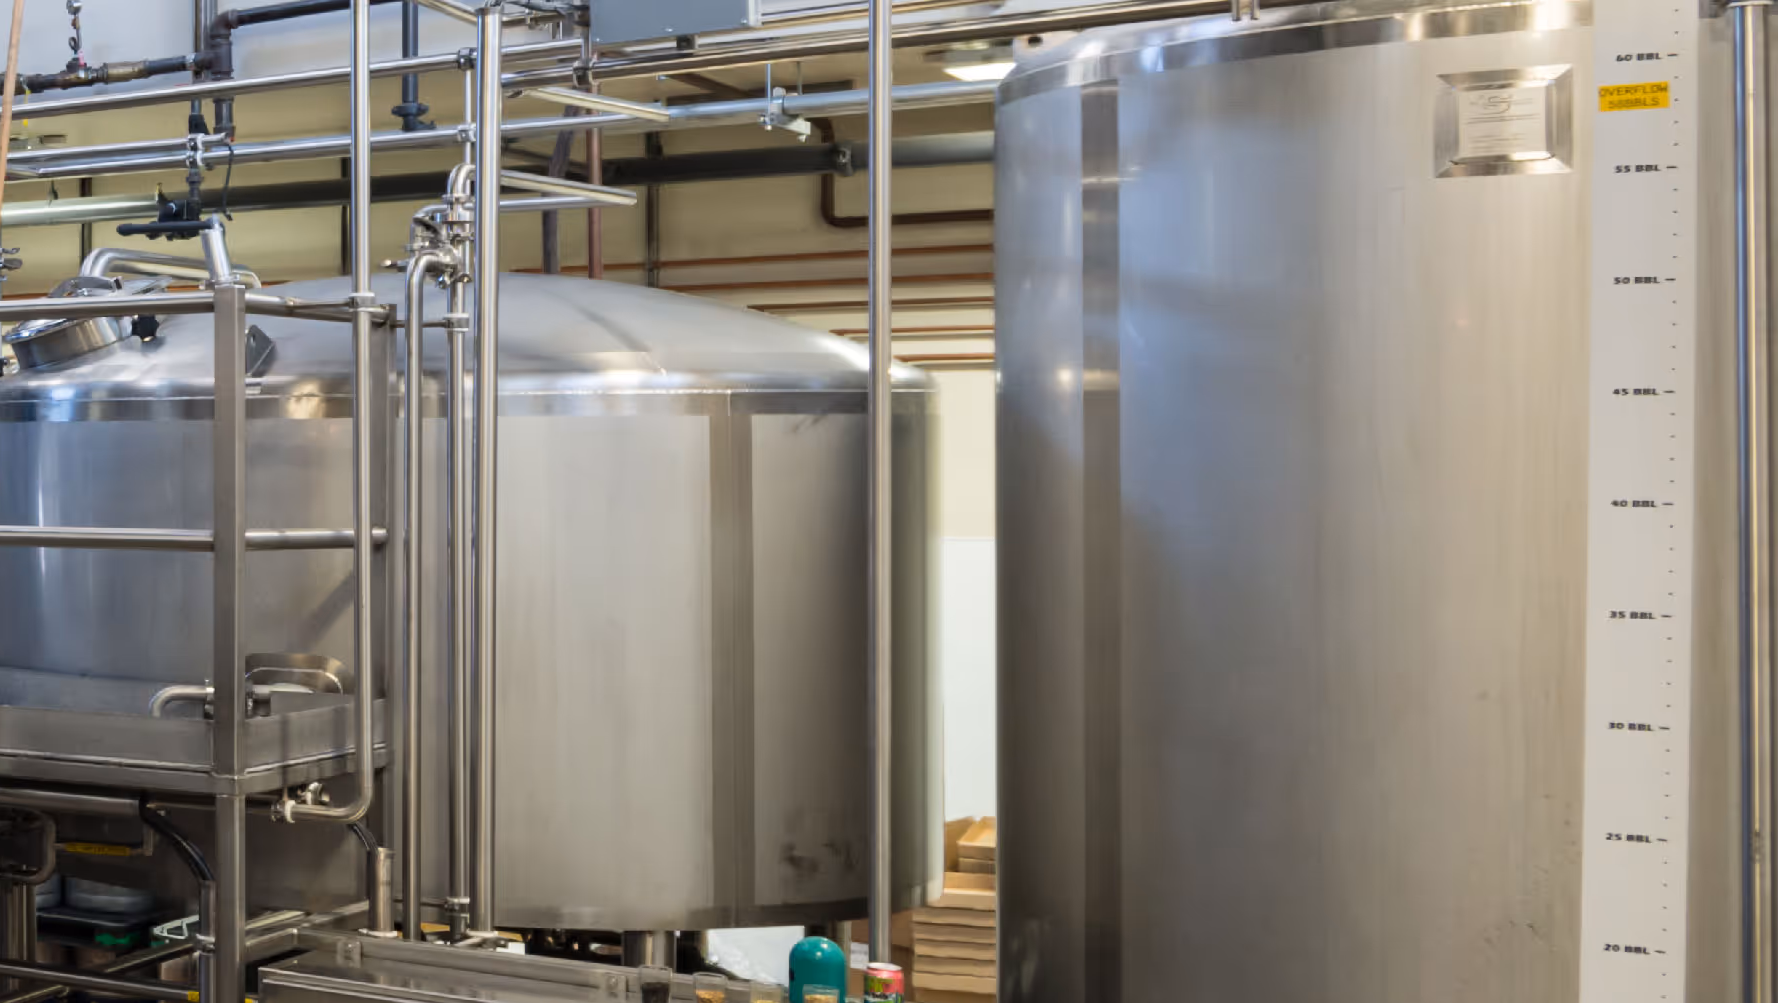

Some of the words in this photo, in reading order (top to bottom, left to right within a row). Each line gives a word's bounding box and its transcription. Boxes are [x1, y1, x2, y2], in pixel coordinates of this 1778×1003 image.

[1616, 53, 1634, 62] 60
[1636, 52, 1662, 61] BBL
[1598, 83, 1668, 98] OVERFLOW
[1614, 164, 1632, 173] 55
[1635, 164, 1662, 172] BBL
[1613, 276, 1631, 285] 50
[1634, 276, 1660, 284] BBL
[1612, 388, 1630, 396] 45
[1633, 387, 1660, 396] BBL
[1611, 499, 1628, 508] 40
[1632, 499, 1658, 508] BBL
[1609, 611, 1626, 619] 35
[1630, 611, 1657, 619] BBL
[1608, 722, 1625, 730] 30
[1628, 722, 1654, 731] BBL
[1606, 832, 1623, 841] 25
[1626, 834, 1652, 843] BBL
[1604, 943, 1620, 952] 20
[1624, 945, 1650, 955] BBL
